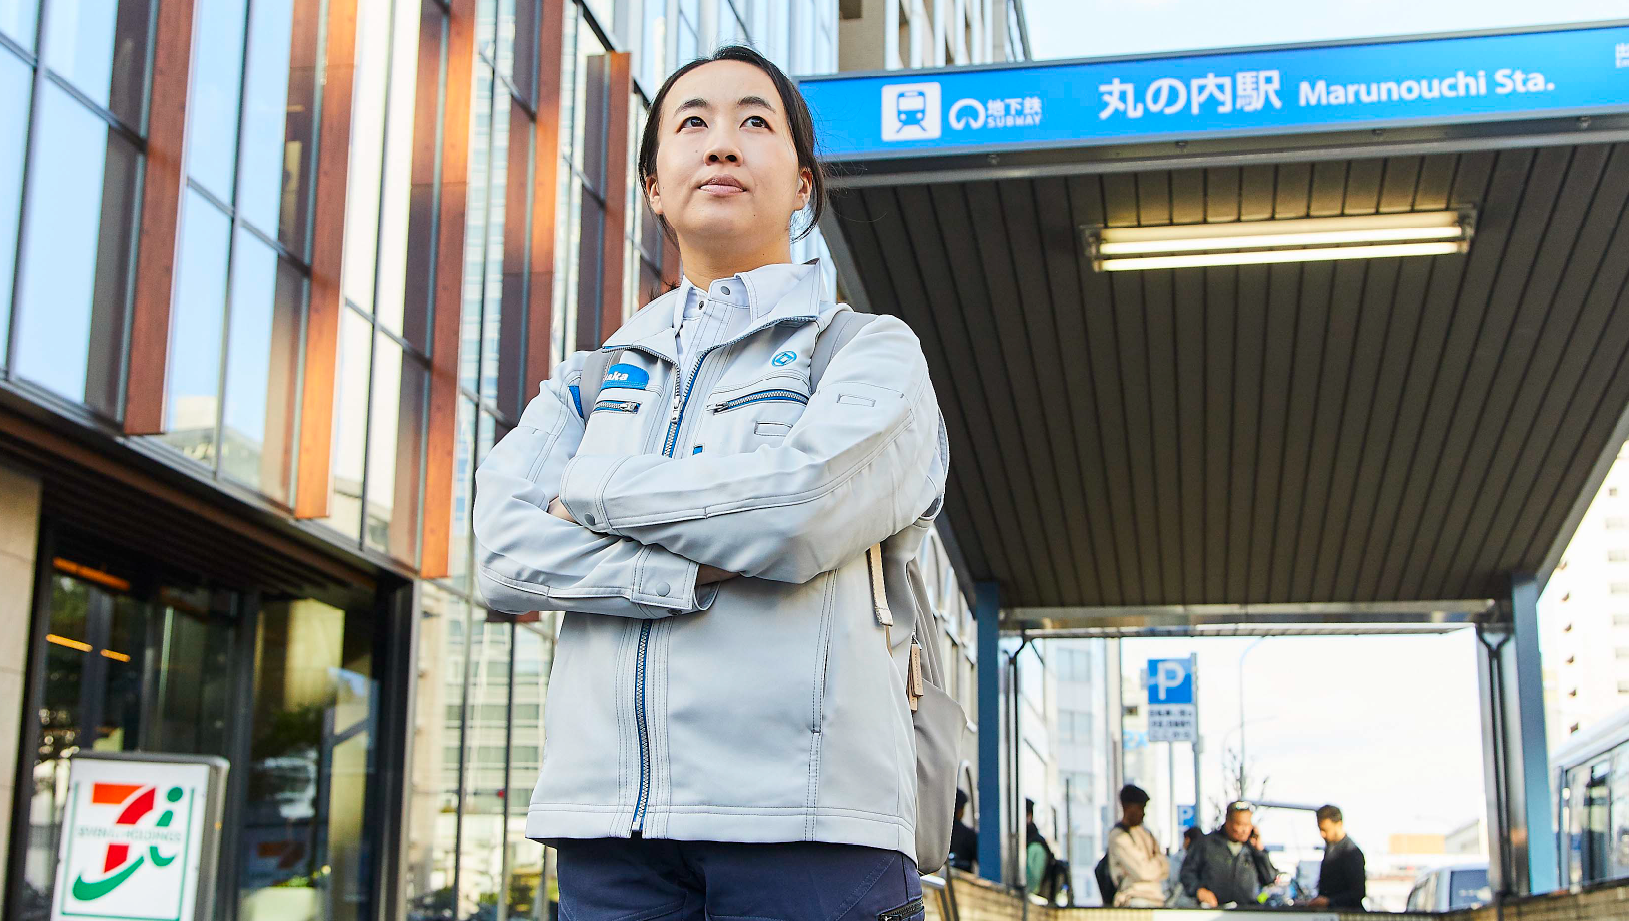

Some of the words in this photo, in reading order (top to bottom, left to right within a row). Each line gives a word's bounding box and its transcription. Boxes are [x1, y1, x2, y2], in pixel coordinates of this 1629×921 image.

[987, 96, 1042, 116] 地下鉄
[1099, 69, 1282, 120] 丸の内駅
[1299, 70, 1487, 107] Marunouchi
[1494, 69, 1555, 95] Sta.
[987, 114, 1041, 129] SUBWAY
[1157, 661, 1185, 700] P
